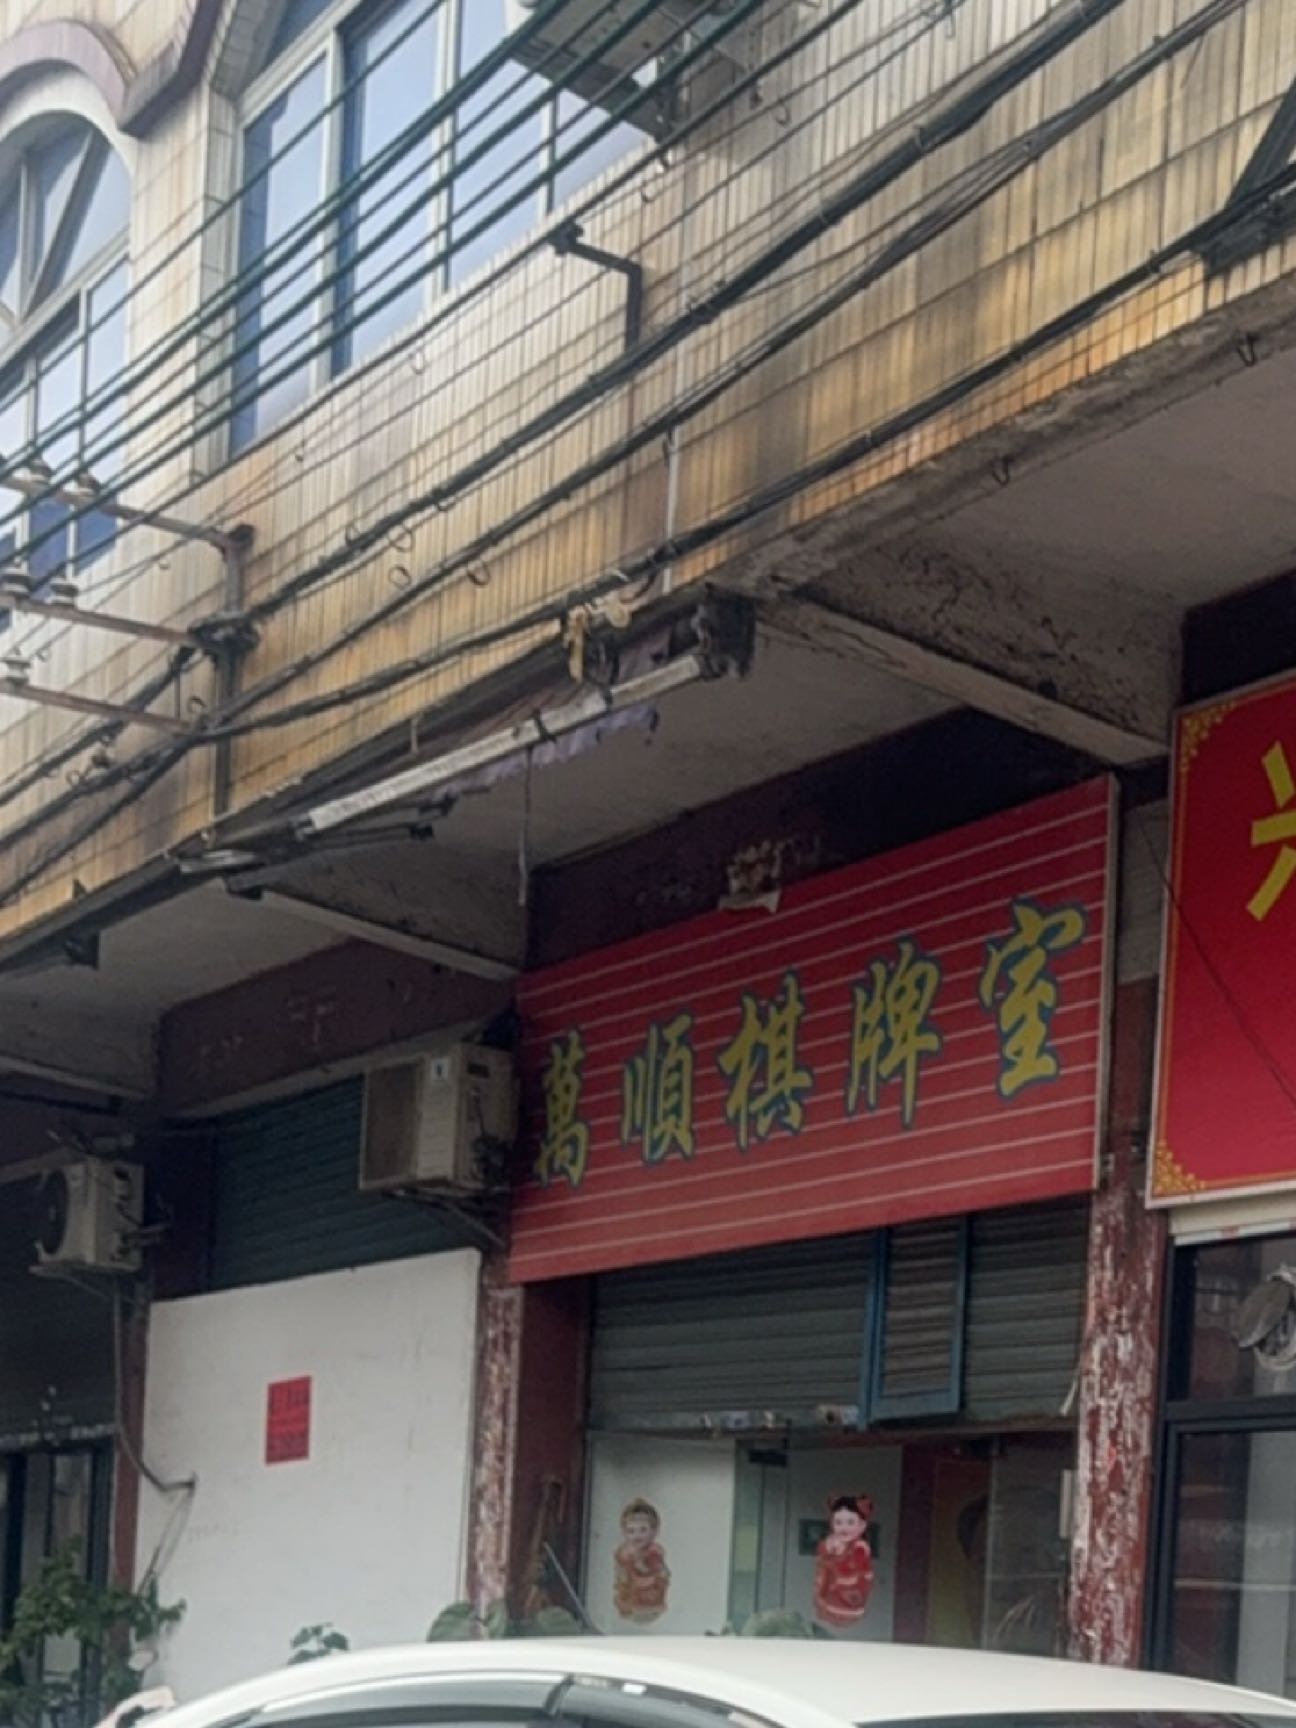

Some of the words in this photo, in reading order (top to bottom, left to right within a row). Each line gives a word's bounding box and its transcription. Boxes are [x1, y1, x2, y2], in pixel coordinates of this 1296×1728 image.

[535, 896, 1086, 1188] 萬順棋牌室
